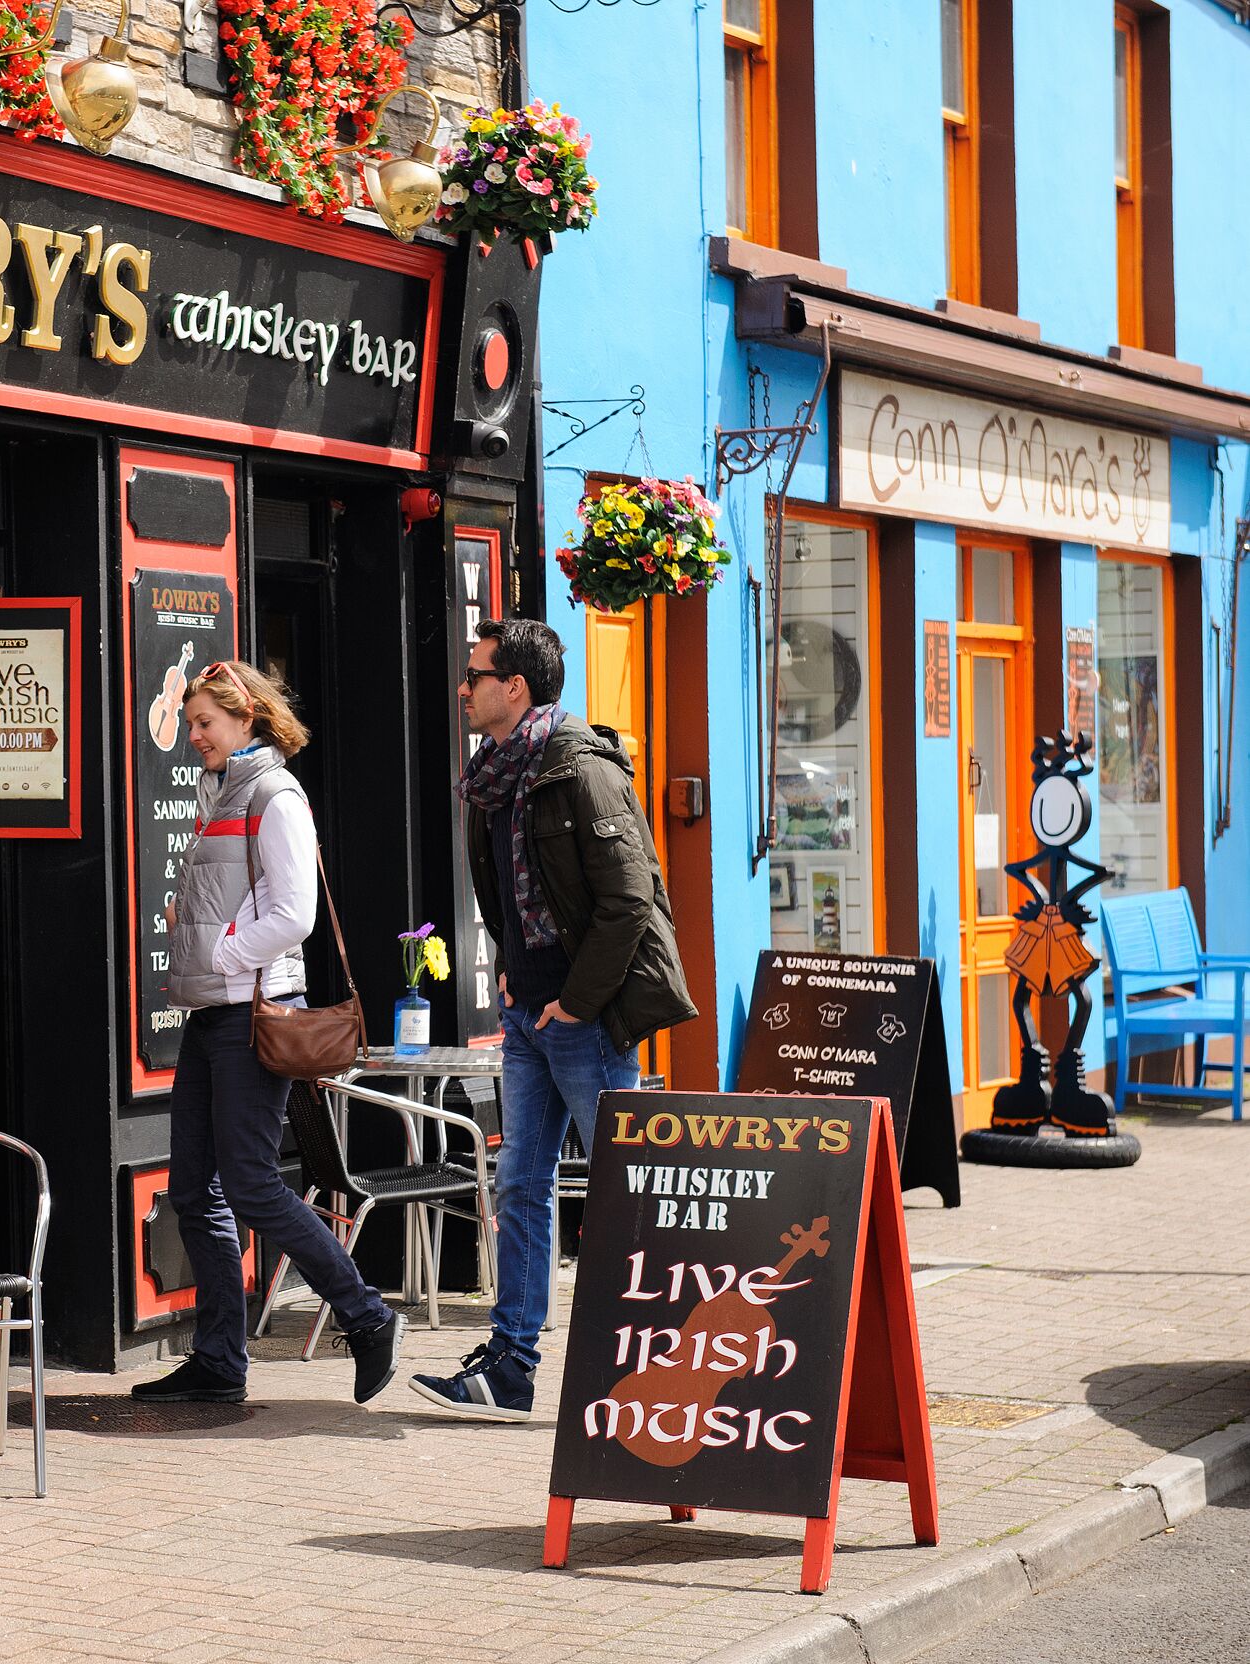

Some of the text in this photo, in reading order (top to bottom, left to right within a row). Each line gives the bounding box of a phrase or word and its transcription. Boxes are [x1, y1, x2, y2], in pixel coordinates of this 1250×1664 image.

[868, 394, 1122, 526] Conn O'Mara's
[152, 587, 221, 614] LOWRY'S
[25, 732, 42, 749] PM
[153, 800, 199, 820] SANDW
[167, 832, 192, 852] PAN
[772, 956, 916, 976] A UNIQUE SOUVENIR
[781, 973, 897, 994] OF CONNEMARA
[778, 1044, 877, 1065] CONN O'MARA
[793, 1067, 855, 1087] T-SHIRTS
[611, 1111, 851, 1153] LOWRY'S
[626, 1165, 776, 1201] WHISKEY
[655, 1200, 728, 1231] BAR
[621, 1250, 812, 1306] LIVE
[584, 1397, 812, 1452] MUSIC
